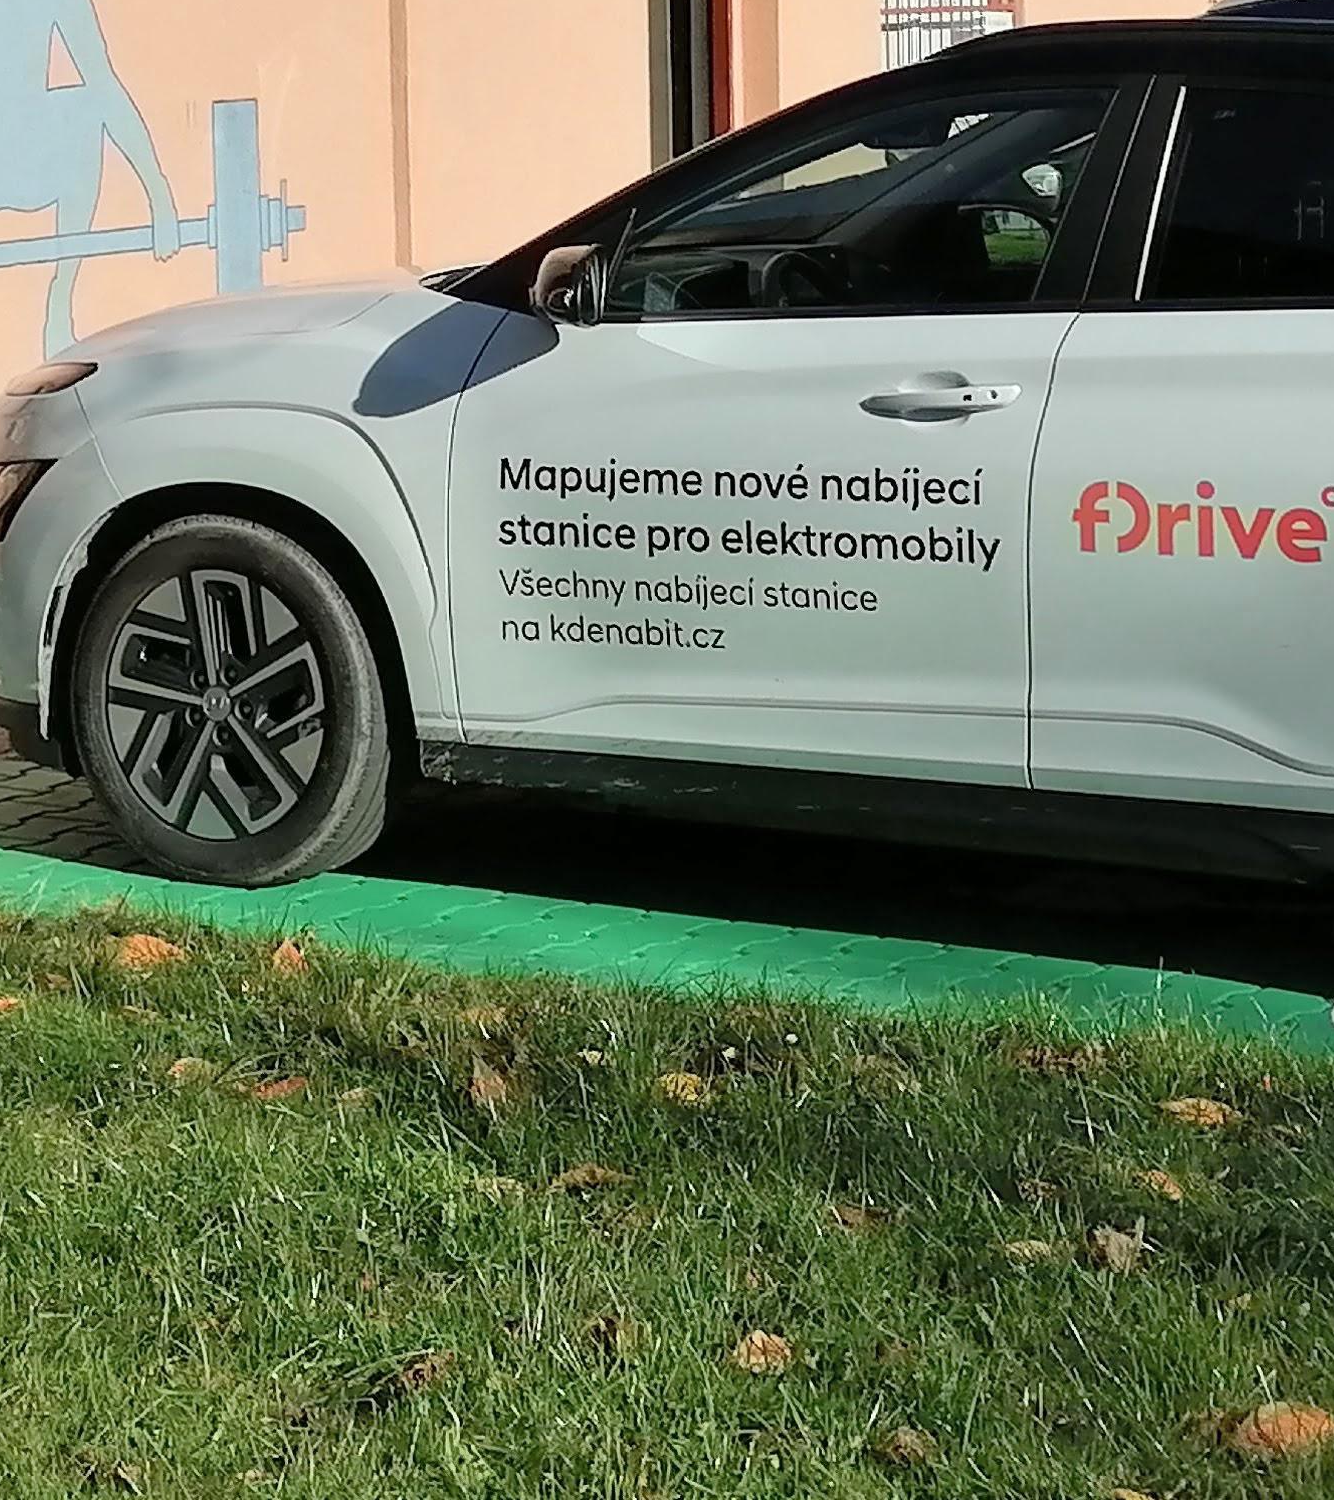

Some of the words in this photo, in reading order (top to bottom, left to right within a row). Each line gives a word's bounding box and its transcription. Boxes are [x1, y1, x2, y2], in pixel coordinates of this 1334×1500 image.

[500, 457, 703, 502] Mapujeme
[715, 463, 809, 501] nové
[821, 467, 984, 512] nabíjecí
[498, 512, 637, 551] stanice
[647, 525, 711, 558] pro
[720, 519, 1001, 573] elektromobily
[498, 567, 627, 608] Všechny
[634, 574, 756, 611] nabíjecí
[763, 580, 879, 612] stanice
[501, 620, 541, 642] na
[549, 613, 727, 650] kdenabit.cz
